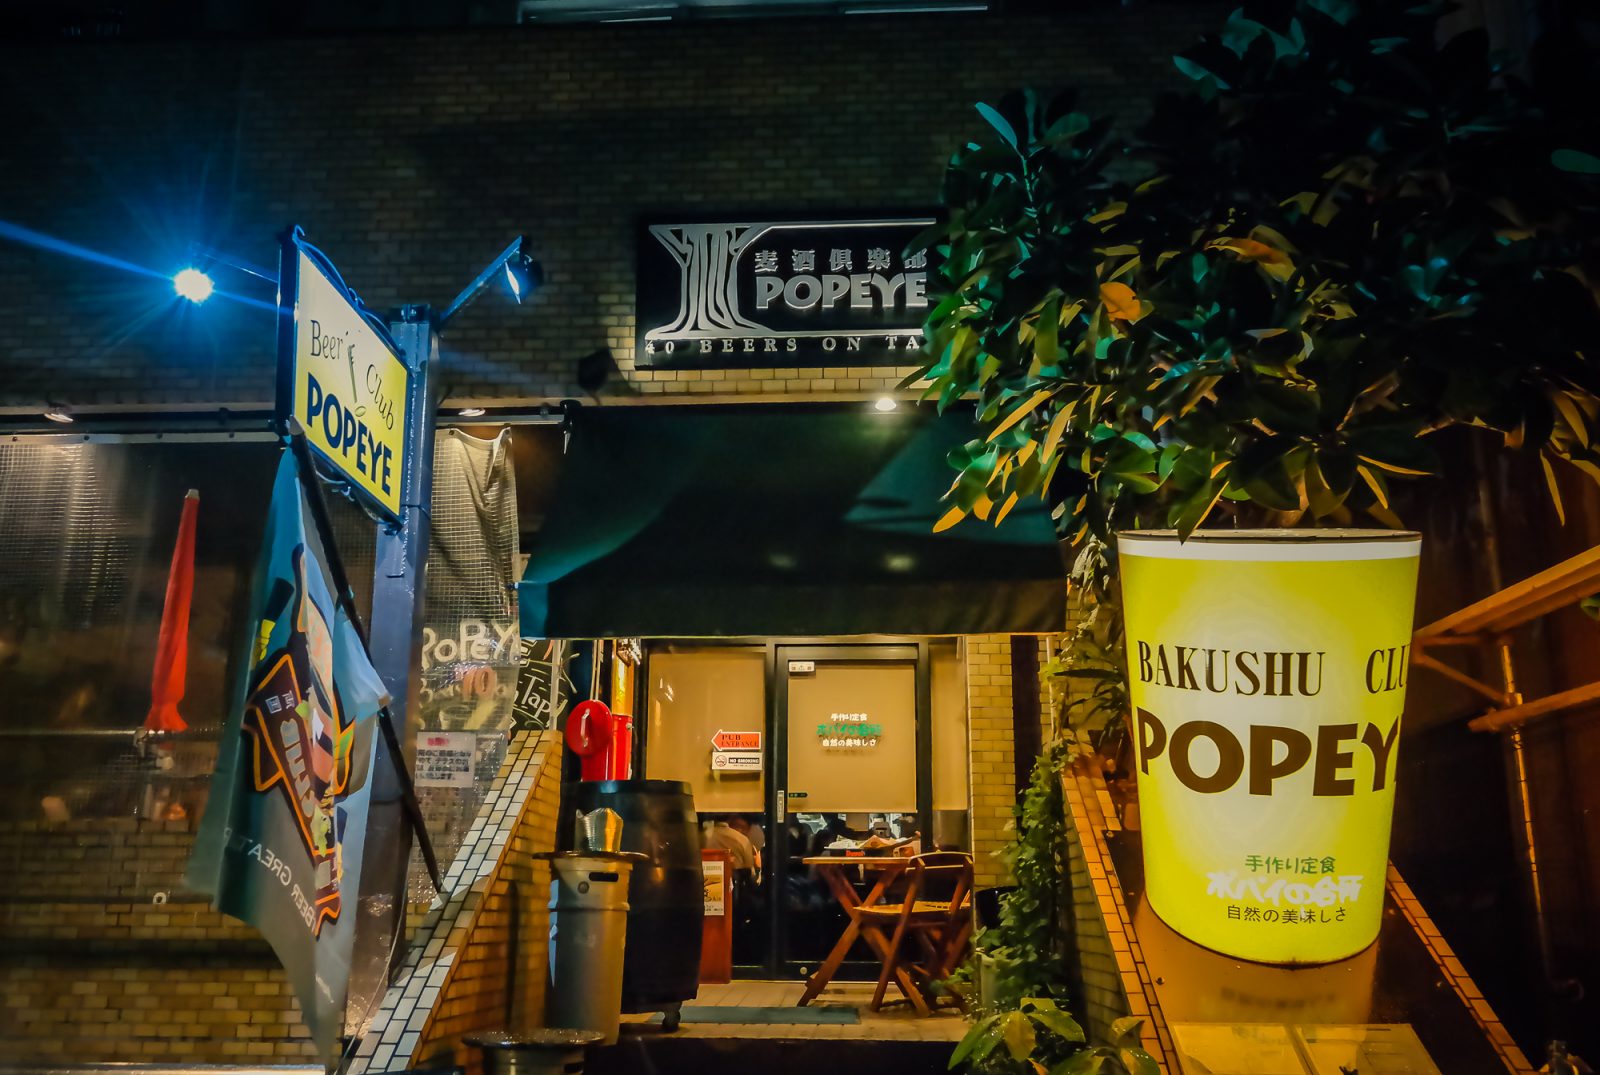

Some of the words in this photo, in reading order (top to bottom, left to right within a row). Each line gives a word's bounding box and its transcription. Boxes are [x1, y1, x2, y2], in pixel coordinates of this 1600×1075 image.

[756, 272, 928, 309] POPEYE
[645, 340, 675, 354] 40
[700, 338, 797, 353] BEERS
[822, 337, 861, 351] ON
[886, 335, 920, 350] TA
[310, 319, 342, 361] Beer
[366, 364, 394, 430] Club
[307, 372, 392, 496] POPEYE
[1138, 641, 1326, 697] BAKUSHU
[1365, 643, 1410, 694] CLU
[1137, 706, 1399, 797] POPEY
[1245, 855, 1336, 874] 手作り定食
[1227, 905, 1347, 924] 自然の美味しさ
